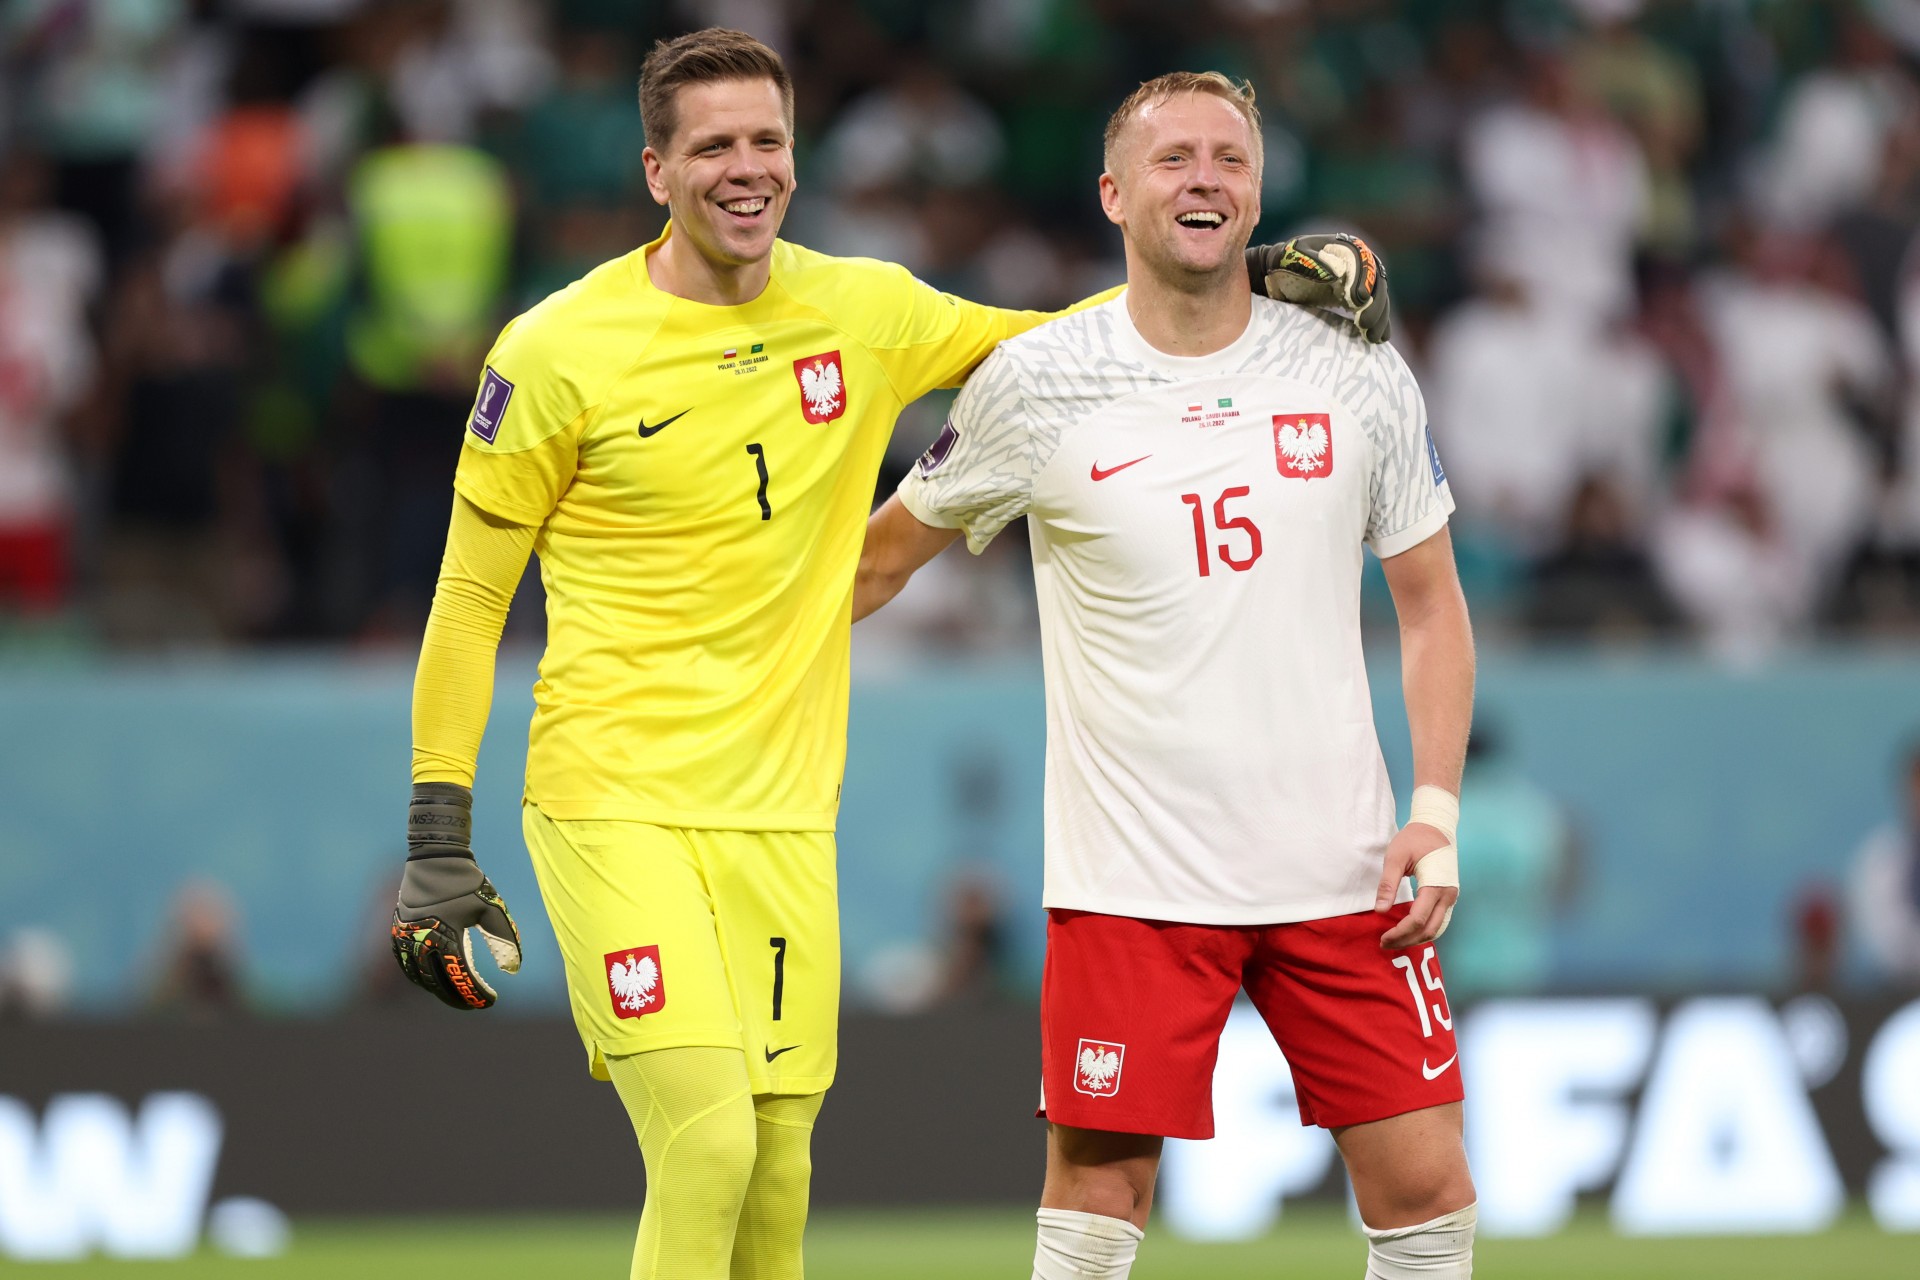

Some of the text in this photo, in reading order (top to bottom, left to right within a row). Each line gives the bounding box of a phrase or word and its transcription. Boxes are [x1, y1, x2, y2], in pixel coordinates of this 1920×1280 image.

[717, 362, 736, 371] POLAND
[739, 359, 753, 367] SAUDI
[753, 355, 769, 364] ARABIA
[1181, 415, 1202, 423] POLAND
[1205, 411, 1221, 420] SAUDI
[1221, 410, 1240, 418] ARABIA
[746, 443, 771, 520] 1
[1181, 485, 1263, 577] 15
[769, 937, 787, 1021] 1
[1391, 946, 1453, 1038] 15
[1157, 996, 1846, 1240] FFA
